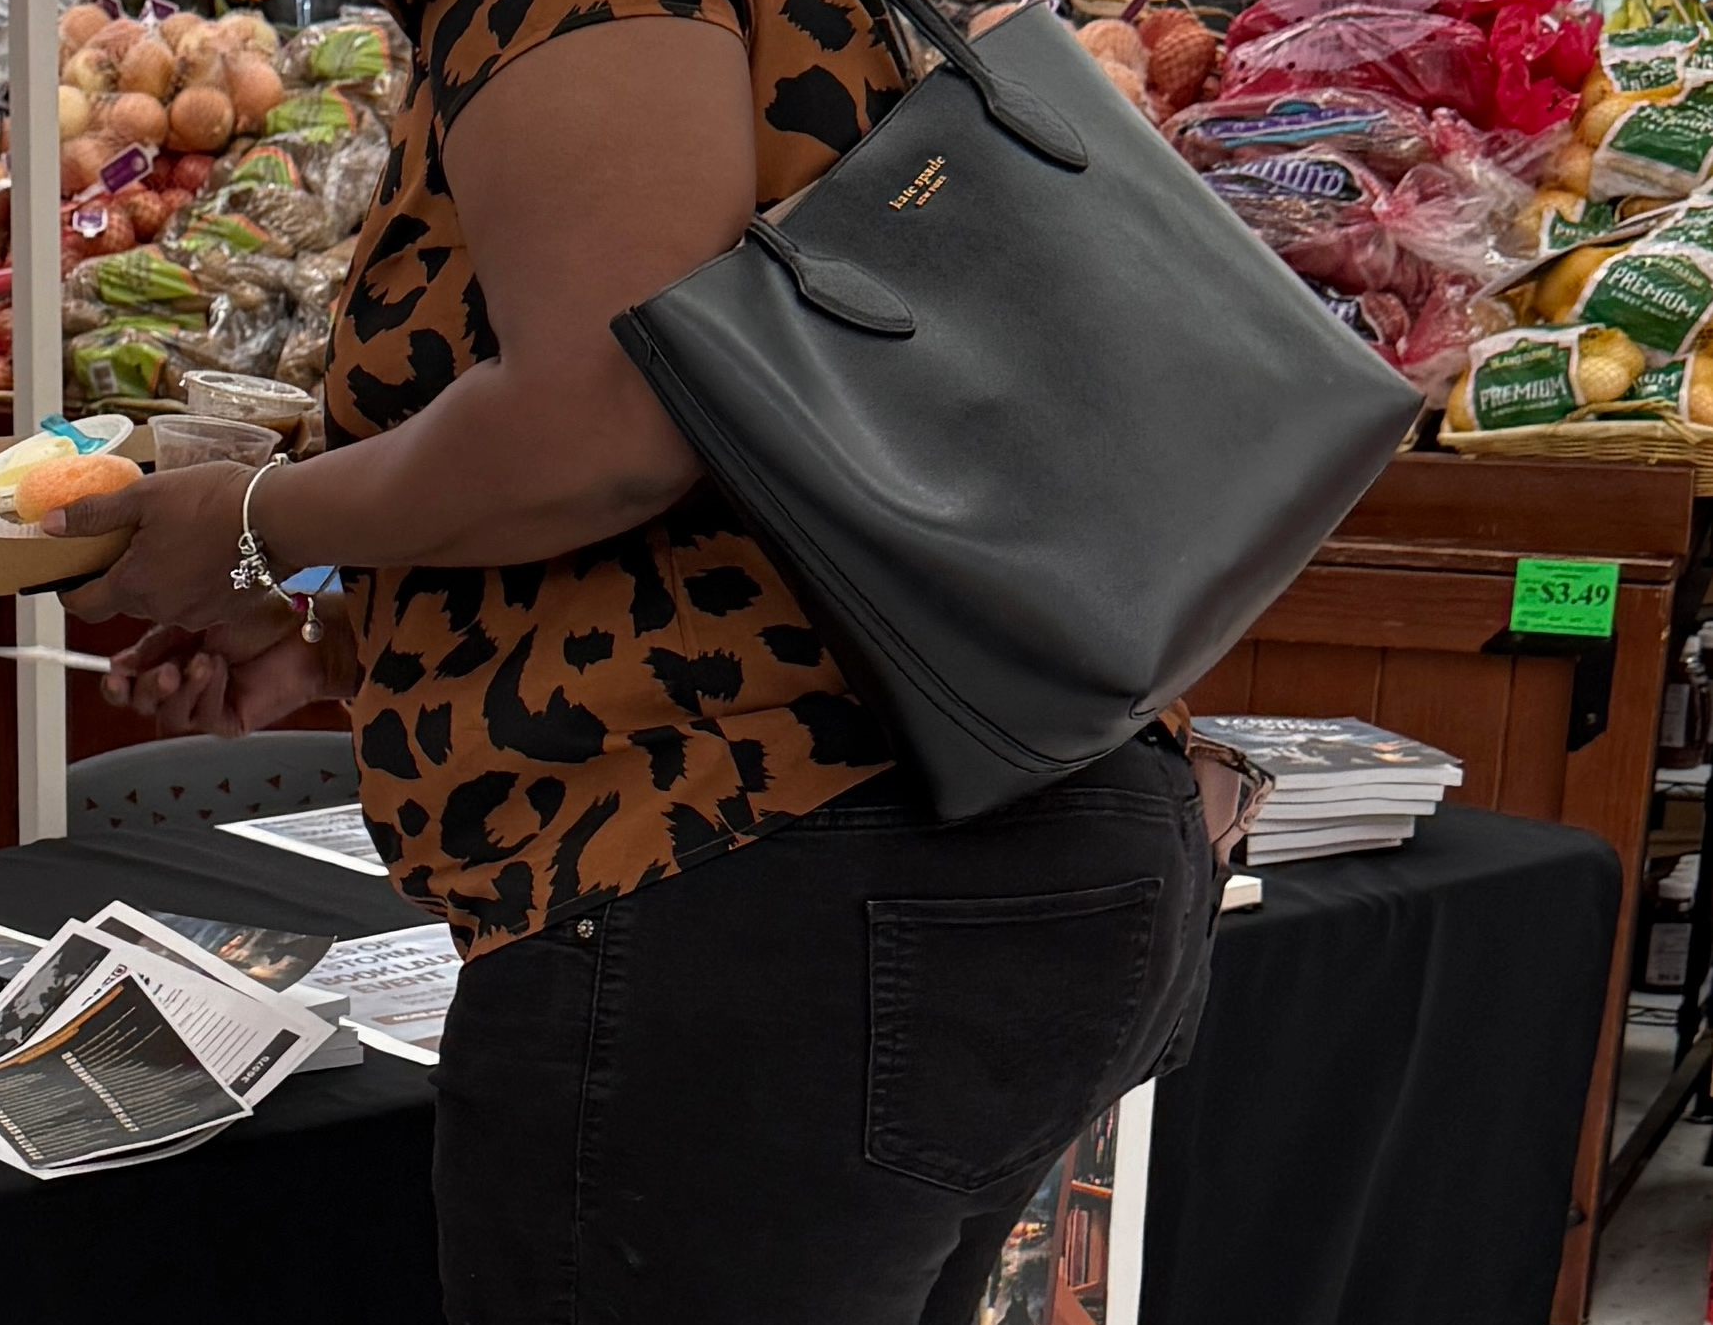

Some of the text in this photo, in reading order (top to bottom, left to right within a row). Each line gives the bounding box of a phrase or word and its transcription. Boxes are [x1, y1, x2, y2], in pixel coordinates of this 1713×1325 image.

[888, 156, 946, 210] kate spade
[1607, 265, 1698, 319] PREMIUM
[1479, 375, 1568, 412] PREMIUM
[1539, 581, 1610, 606] $3.49
[357, 939, 397, 952] OF
[322, 947, 424, 971] STORM
[313, 966, 397, 986] BOOK
[351, 971, 447, 994] EVENT
